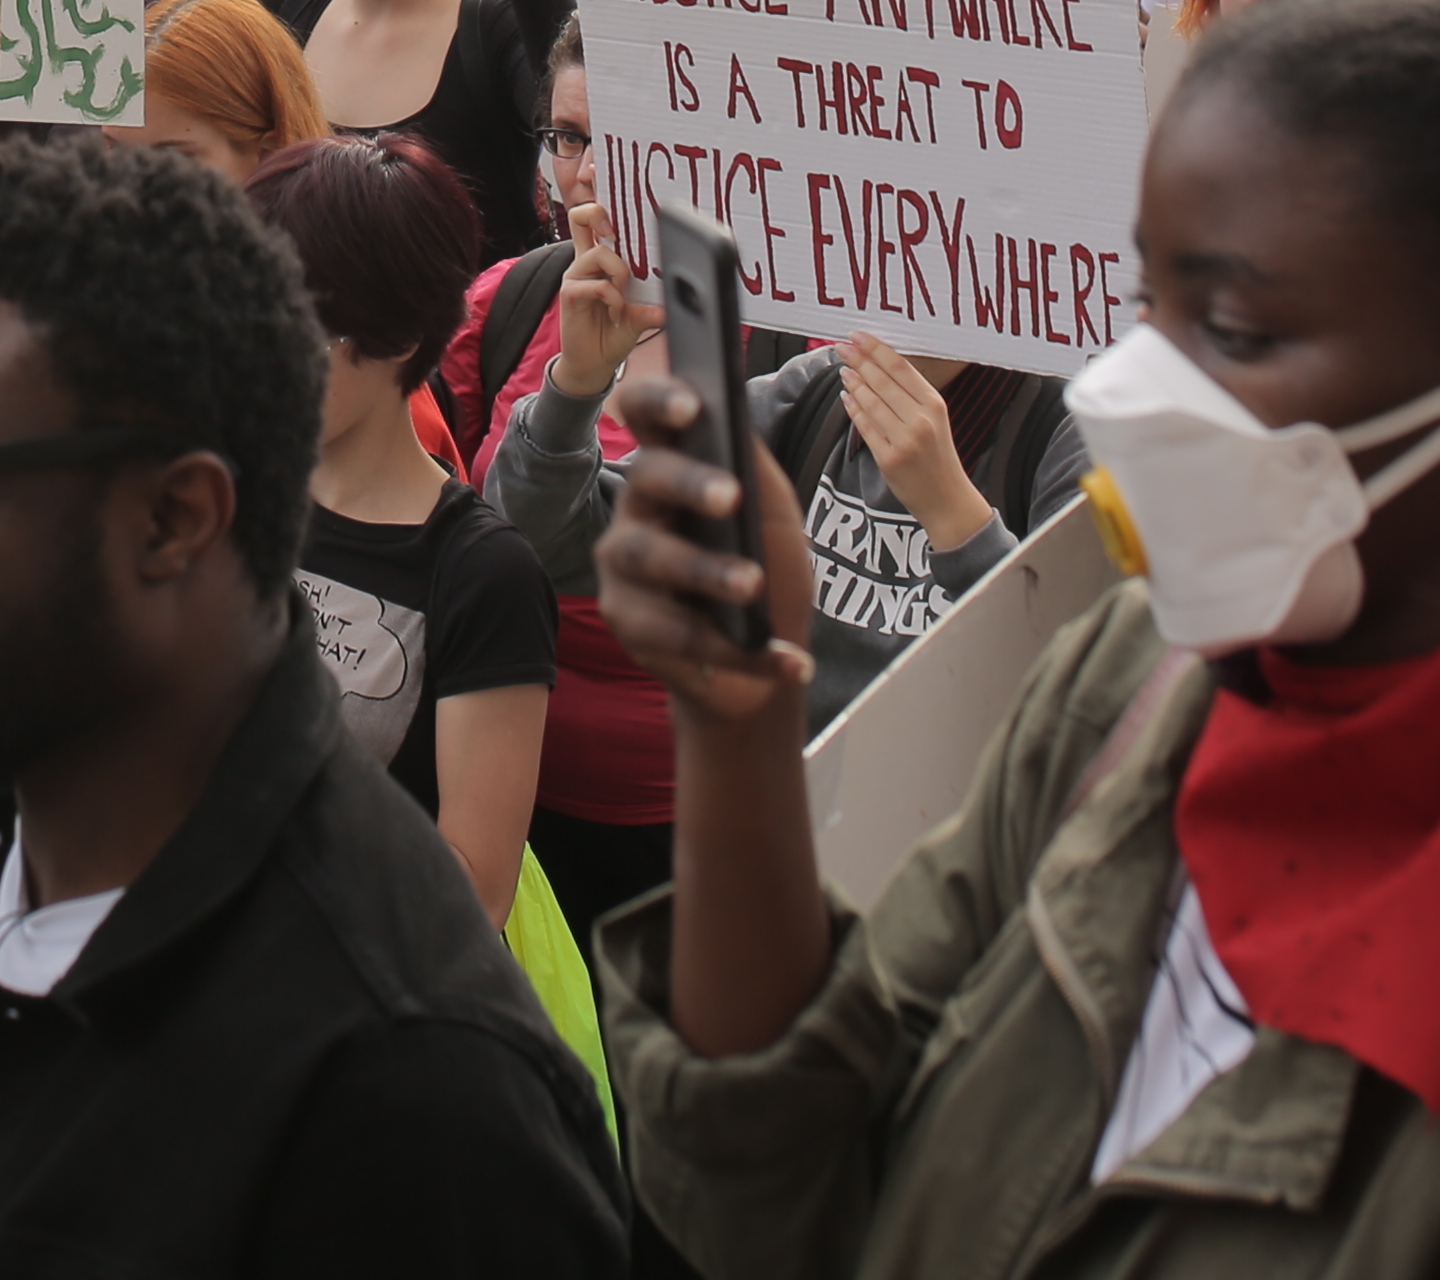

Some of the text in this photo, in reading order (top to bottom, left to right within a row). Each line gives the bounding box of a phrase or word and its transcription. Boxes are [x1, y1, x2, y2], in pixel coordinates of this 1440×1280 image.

[664, 41, 1023, 150] IS A THREAT TO
[807, 173, 1122, 348] EVERYWHERE
[807, 545, 955, 637] HINGS
